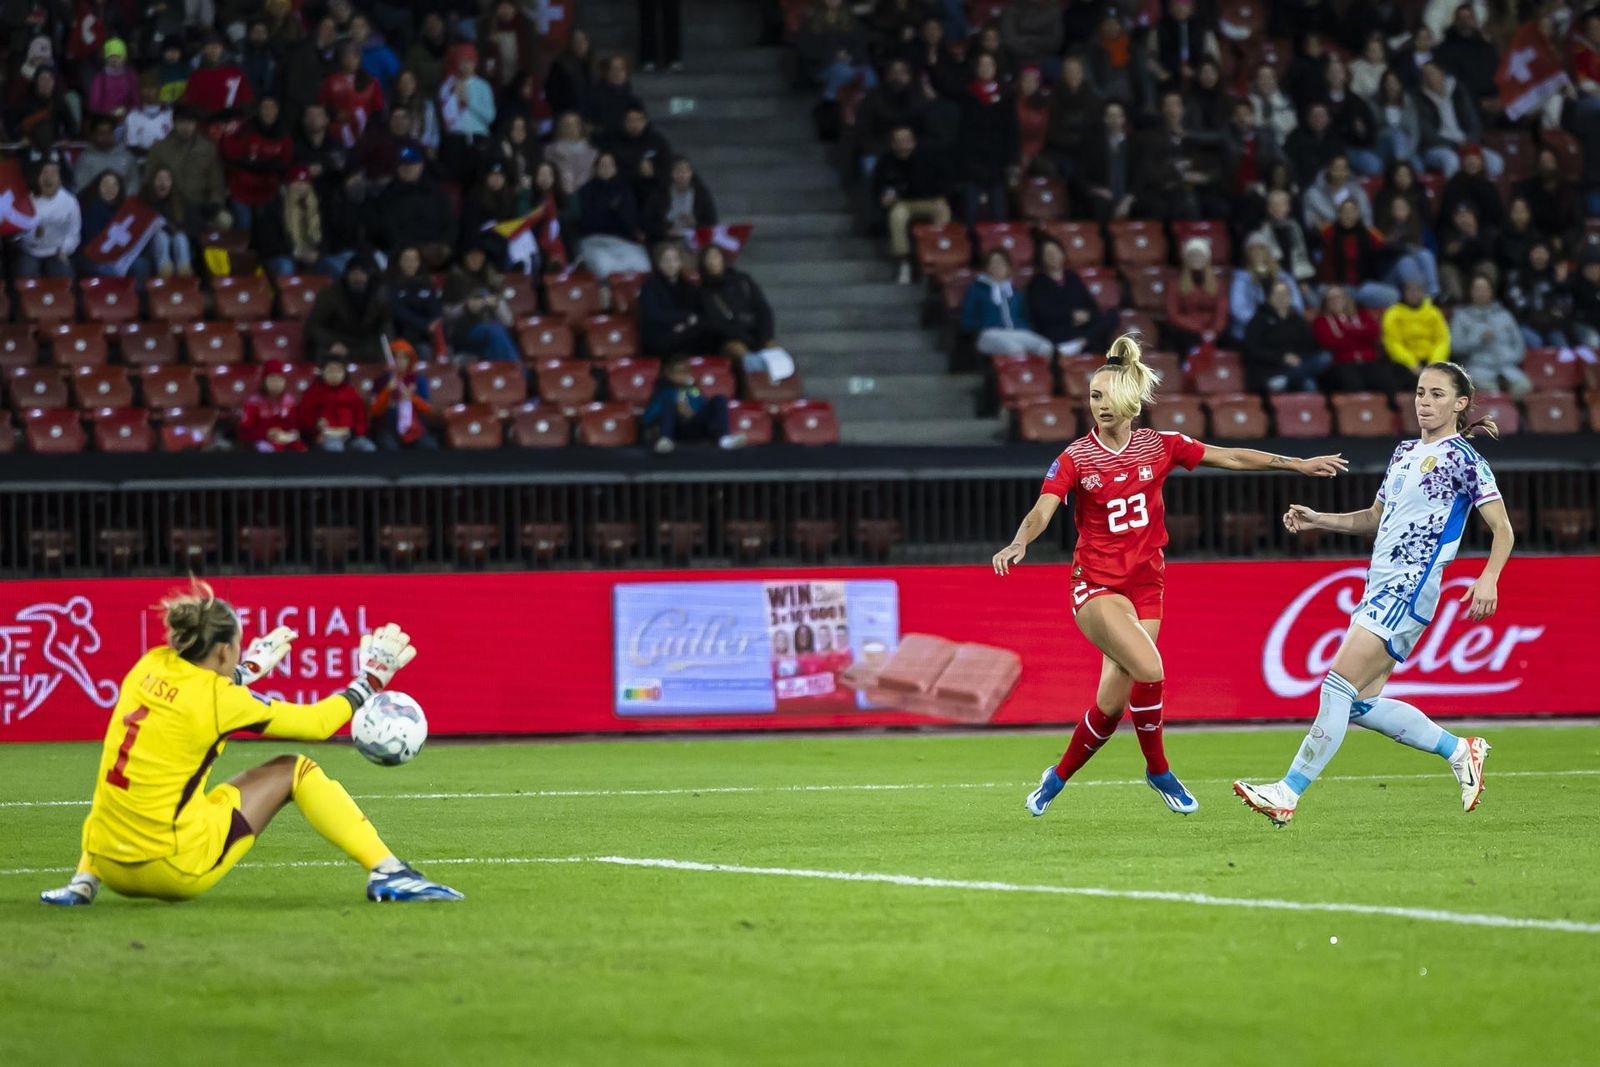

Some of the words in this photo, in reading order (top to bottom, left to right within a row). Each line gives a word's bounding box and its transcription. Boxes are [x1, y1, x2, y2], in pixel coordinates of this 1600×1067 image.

[1106, 493, 1150, 533] 23
[766, 584, 812, 609] WIN
[105, 703, 150, 791] 1
